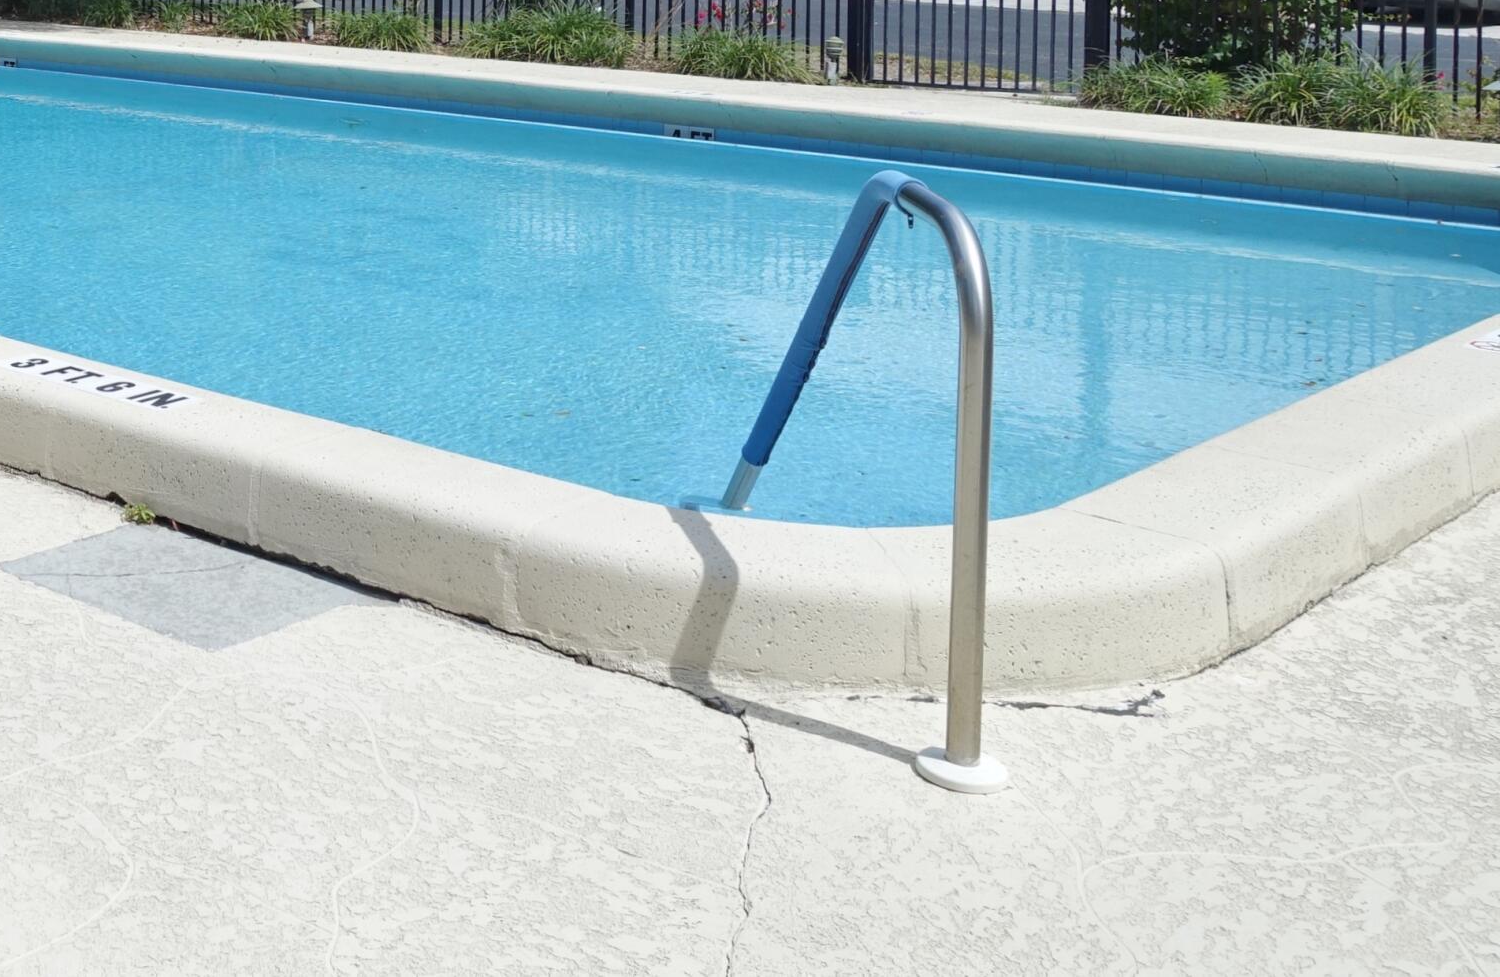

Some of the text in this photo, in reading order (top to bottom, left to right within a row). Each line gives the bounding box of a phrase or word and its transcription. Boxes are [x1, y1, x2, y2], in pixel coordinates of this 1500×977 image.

[691, 131, 712, 141] FT
[10, 358, 189, 409] 3 FT. 6 IN.
